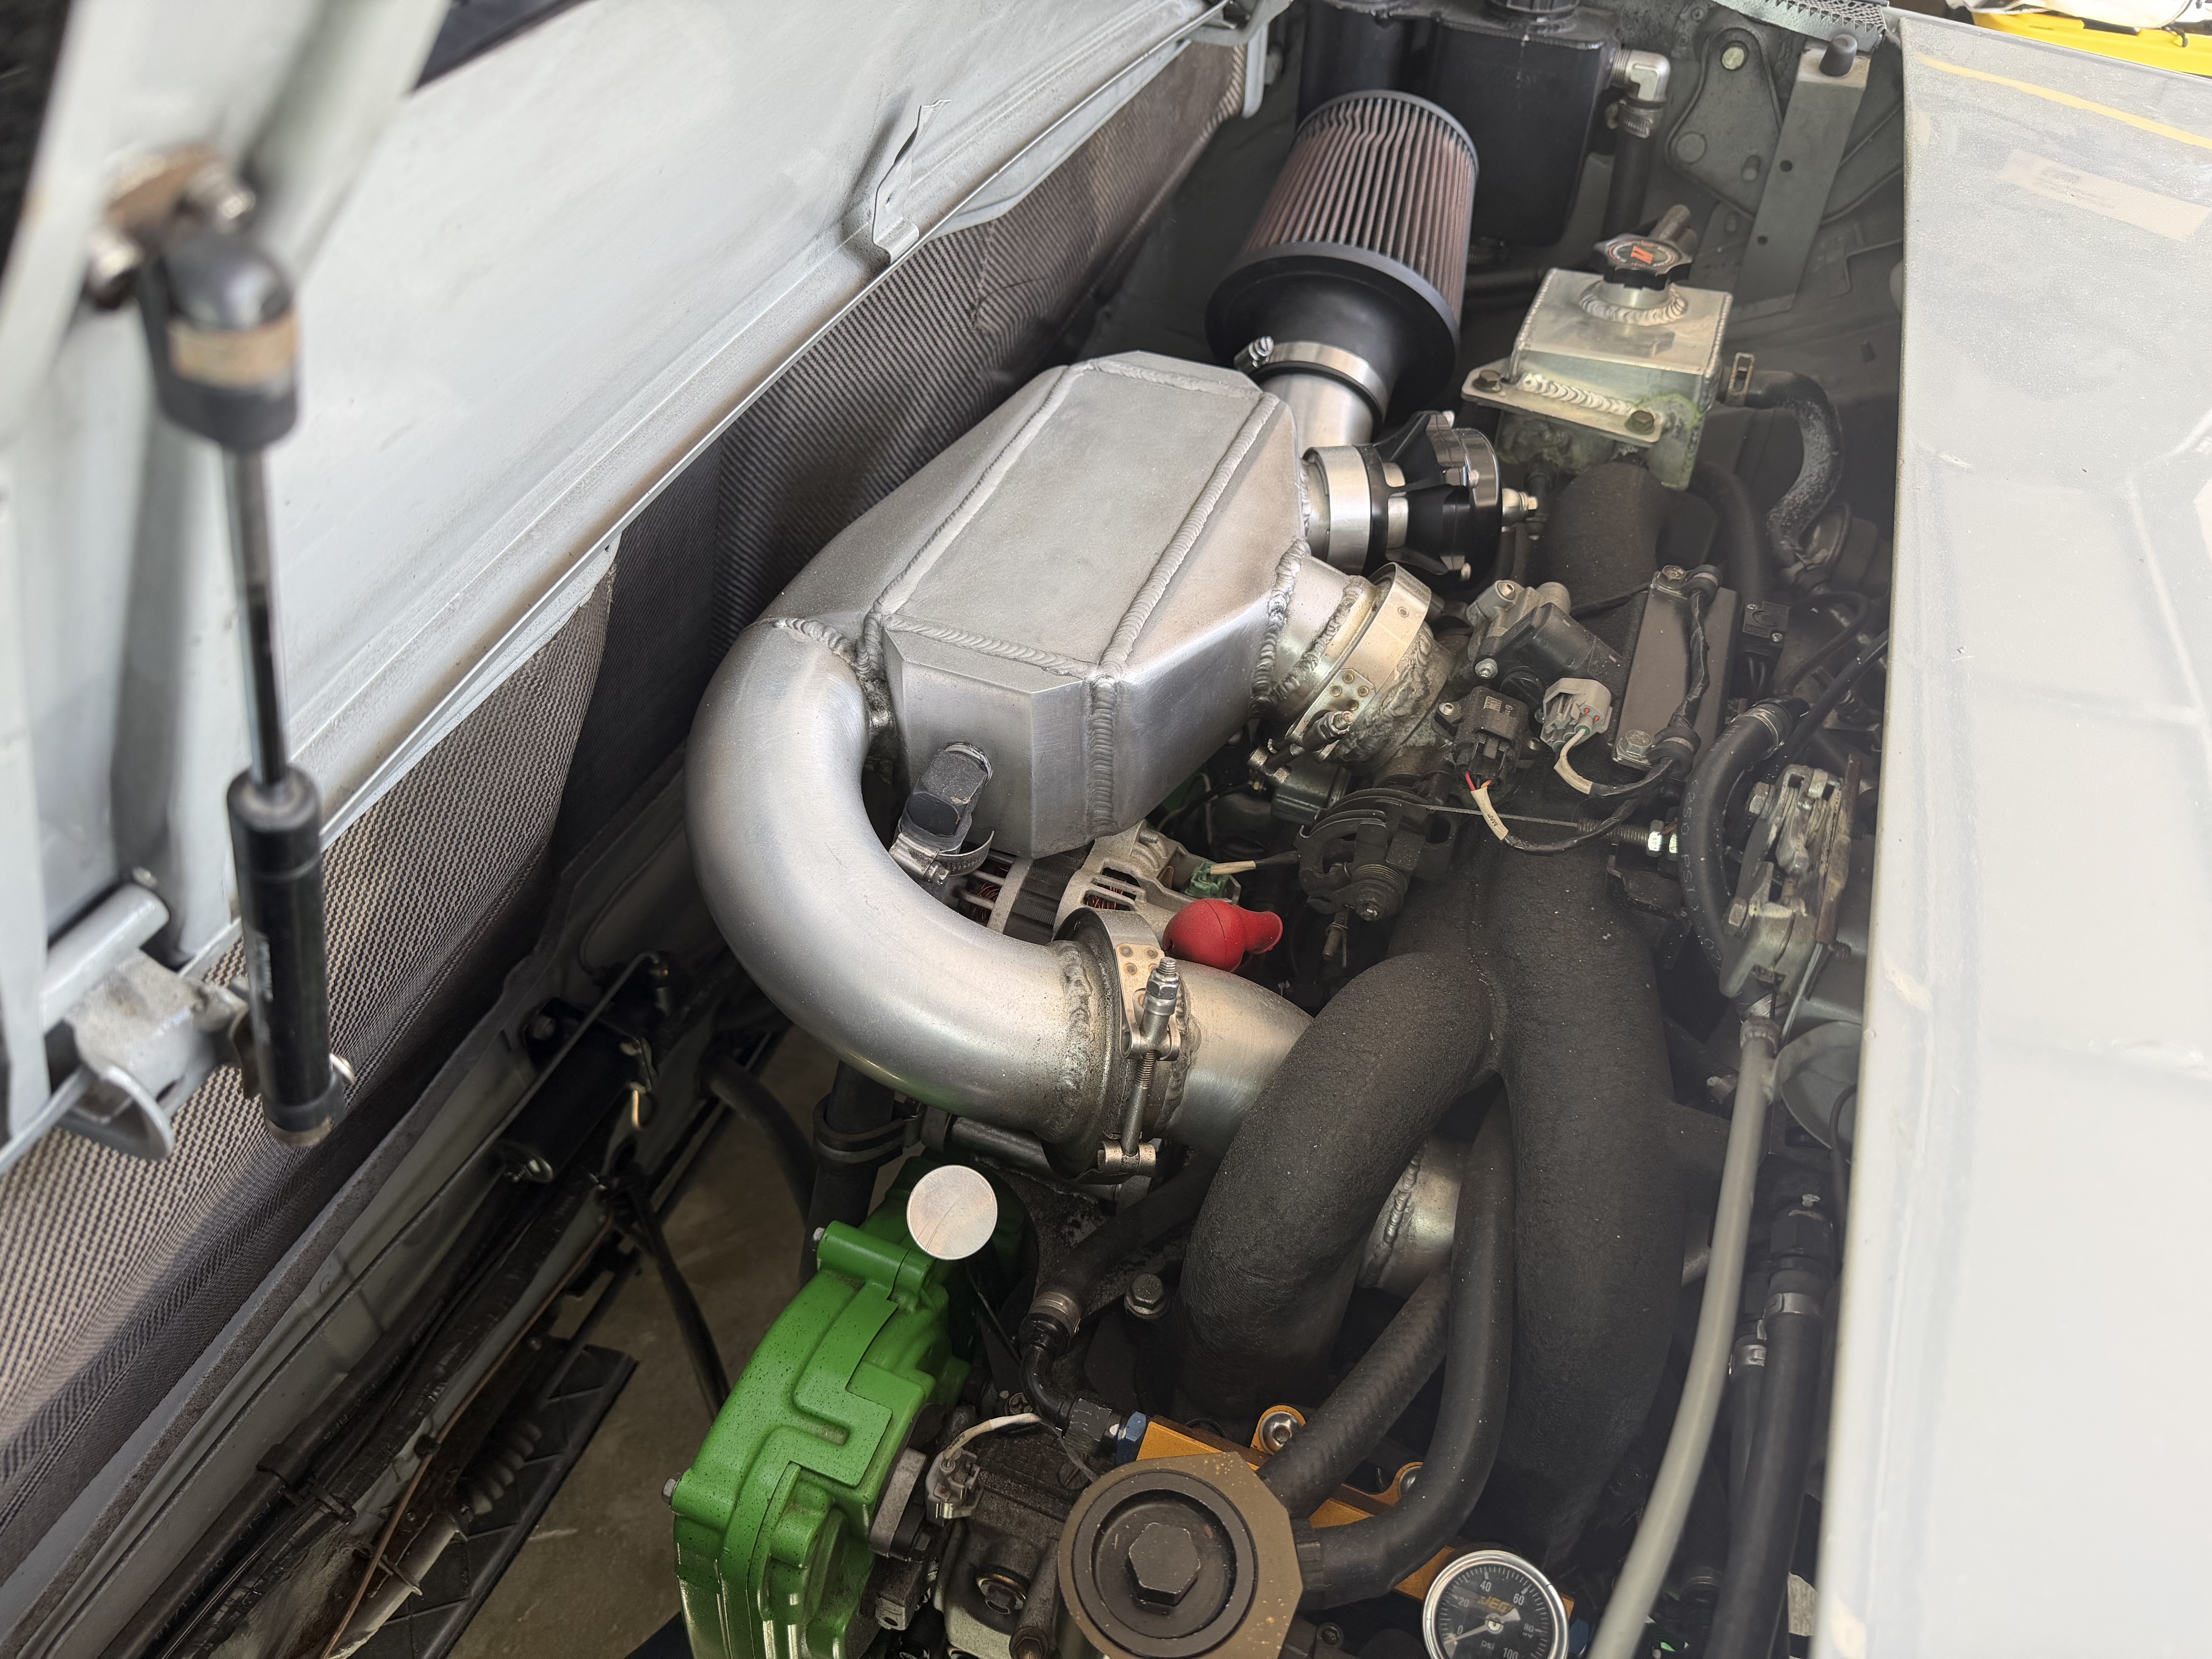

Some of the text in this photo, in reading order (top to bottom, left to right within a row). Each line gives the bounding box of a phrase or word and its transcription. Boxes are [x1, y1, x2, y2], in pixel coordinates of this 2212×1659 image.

[1487, 814, 1498, 826] MAP
[1480, 1580, 1491, 1592] 40
[1458, 1597, 1469, 1607] 20
[1513, 1593, 1525, 1606] 60
[1457, 1625, 1463, 1635] 0
[1480, 1641, 1495, 1650] psi
[1503, 1647, 1519, 1659] 100
